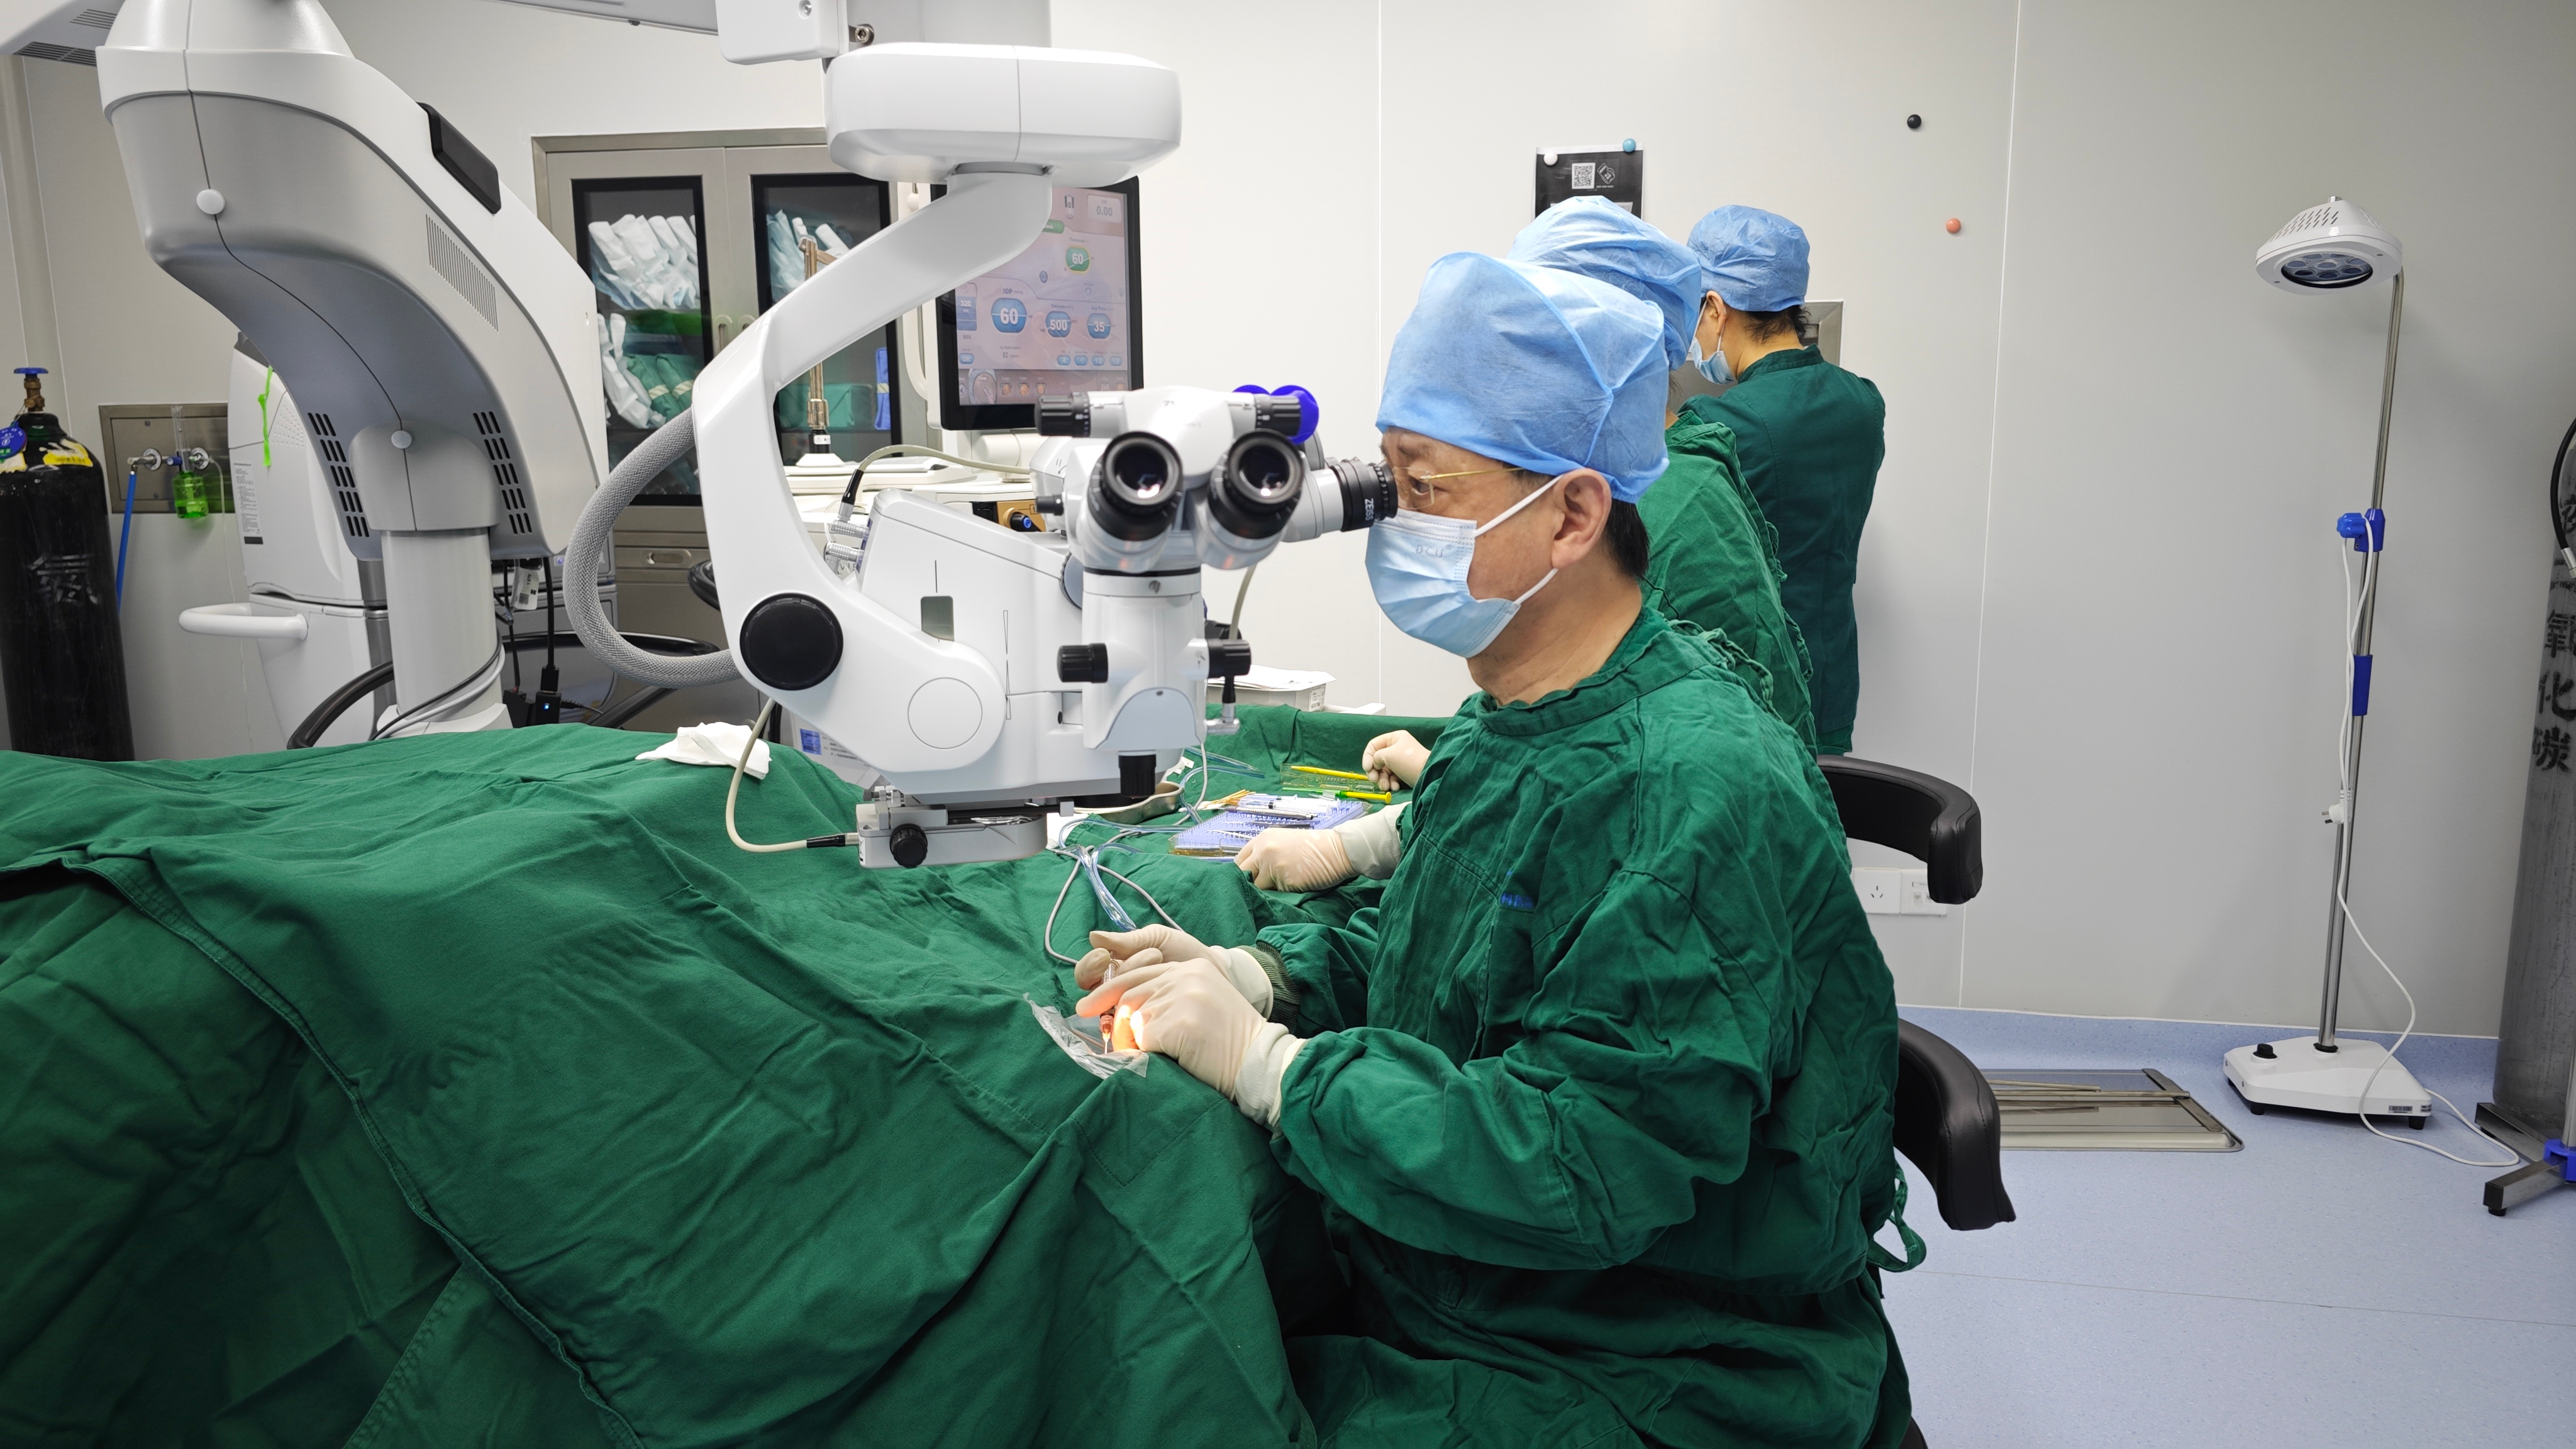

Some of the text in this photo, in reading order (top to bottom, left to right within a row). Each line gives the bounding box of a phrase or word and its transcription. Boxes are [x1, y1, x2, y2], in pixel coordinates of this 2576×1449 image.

[1096, 205, 1113, 216] 0.00
[1072, 253, 1084, 265] 60
[1000, 308, 1018, 325] 60
[1050, 319, 1068, 331] 500
[1094, 321, 1105, 333] 35
